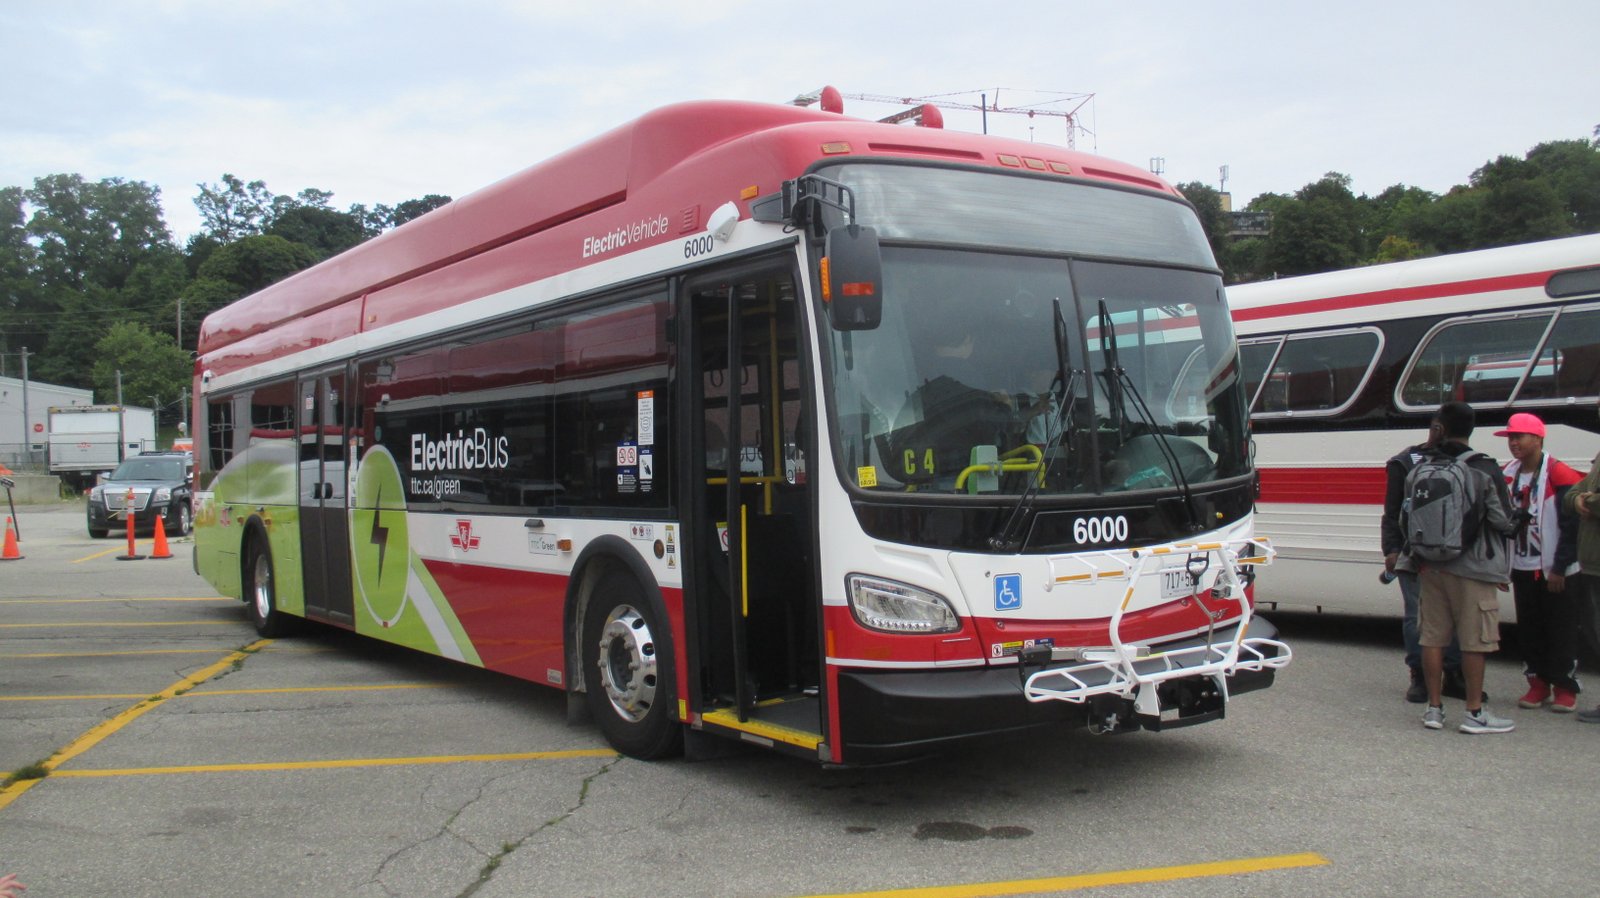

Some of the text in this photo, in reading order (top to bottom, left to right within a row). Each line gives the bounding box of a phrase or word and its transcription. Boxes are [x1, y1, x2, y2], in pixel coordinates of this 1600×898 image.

[684, 234, 714, 258] 6000
[411, 475, 461, 499] ttc.ca/green
[1073, 515, 1129, 544] 6000
[541, 540, 556, 550] Green
